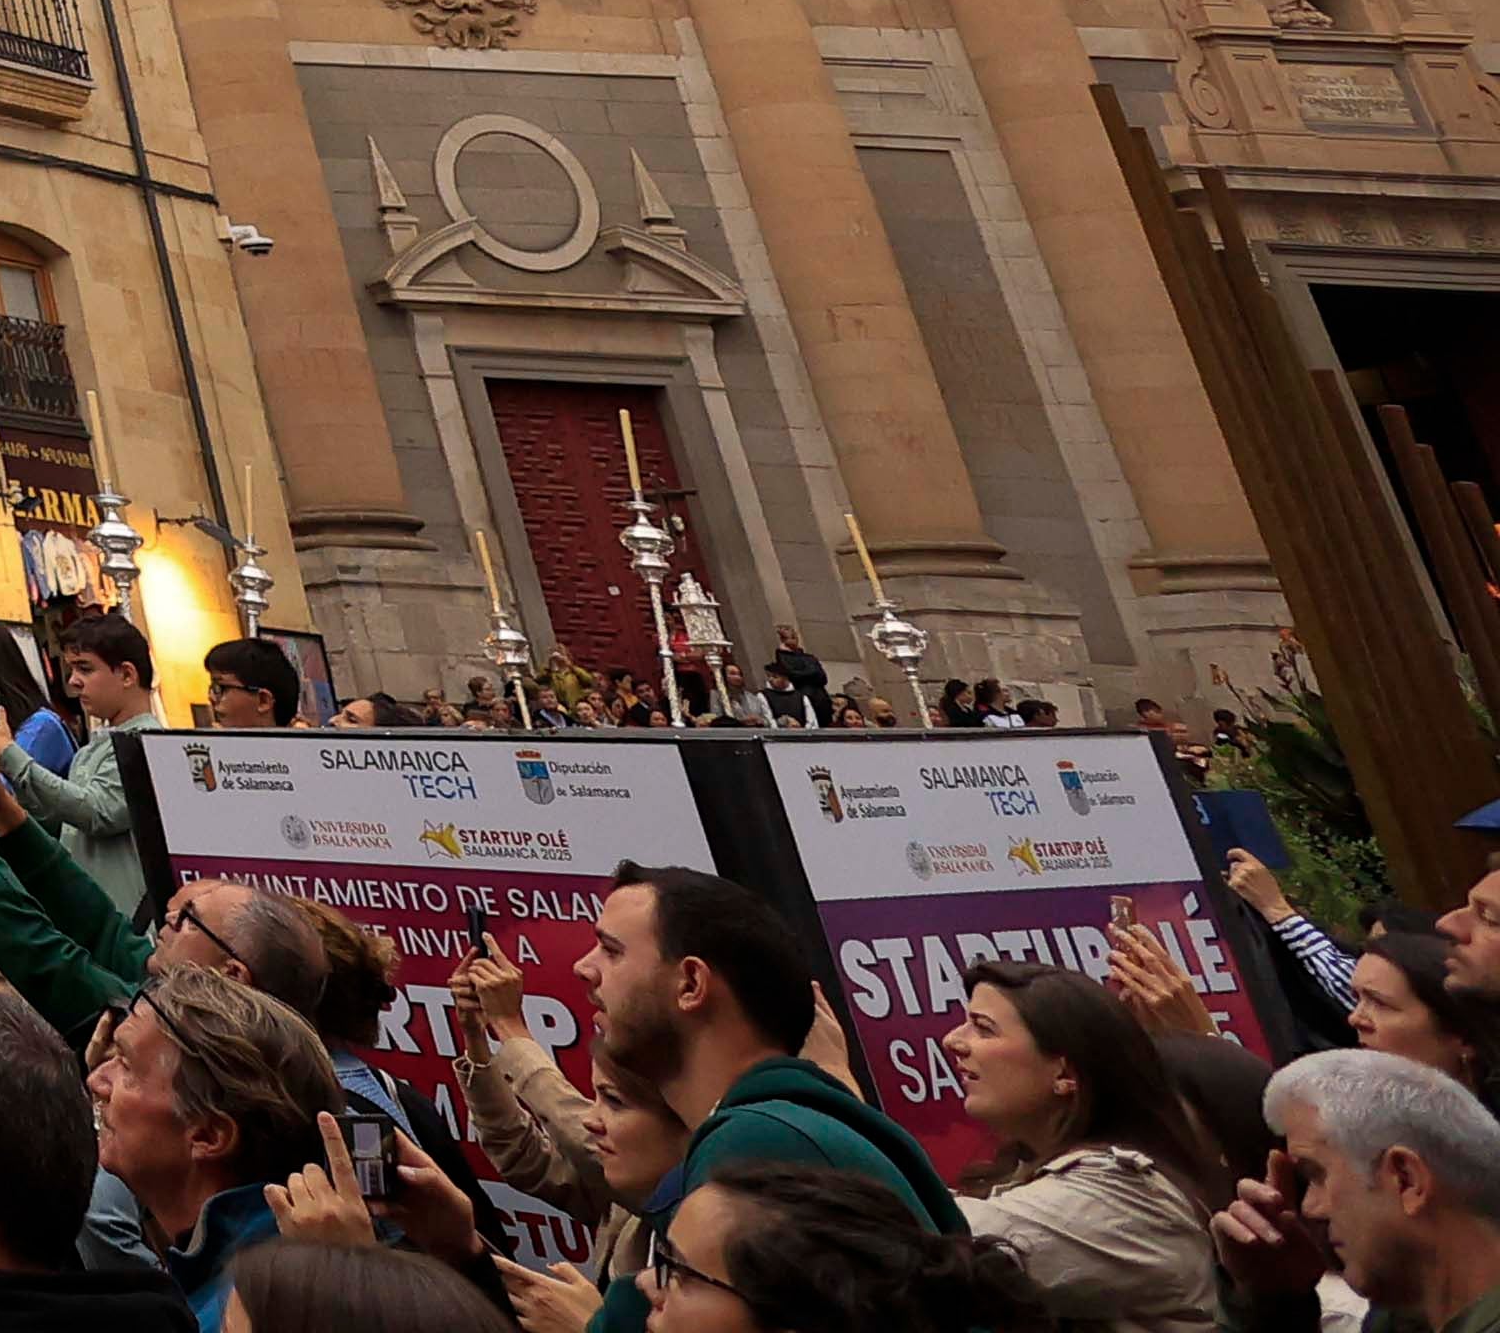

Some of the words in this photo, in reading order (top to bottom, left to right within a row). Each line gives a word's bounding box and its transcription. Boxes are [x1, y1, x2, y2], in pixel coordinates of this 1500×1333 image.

[8, 480, 100, 528] RMA
[218, 760, 289, 775] Ayuntamiento
[320, 749, 469, 773] SALAMANCA
[550, 761, 612, 776] Diputación
[222, 778, 234, 790] de
[237, 778, 294, 792] Salamanca
[402, 774, 477, 800] TECH
[920, 765, 1030, 790] SALAMANCA
[556, 787, 567, 797] de
[570, 786, 631, 799] Salamanca
[985, 790, 1040, 817] TECH
[458, 829, 533, 847] STARTUP
[536, 829, 569, 848] OLÉ
[464, 846, 539, 861] SALAMANCA
[541, 848, 572, 862] 2025
[1033, 841, 1084, 858] STARTUP
[455, 885, 500, 916] DE
[507, 888, 605, 923] SALA
[398, 926, 471, 959] INVI
[518, 935, 540, 965] A
